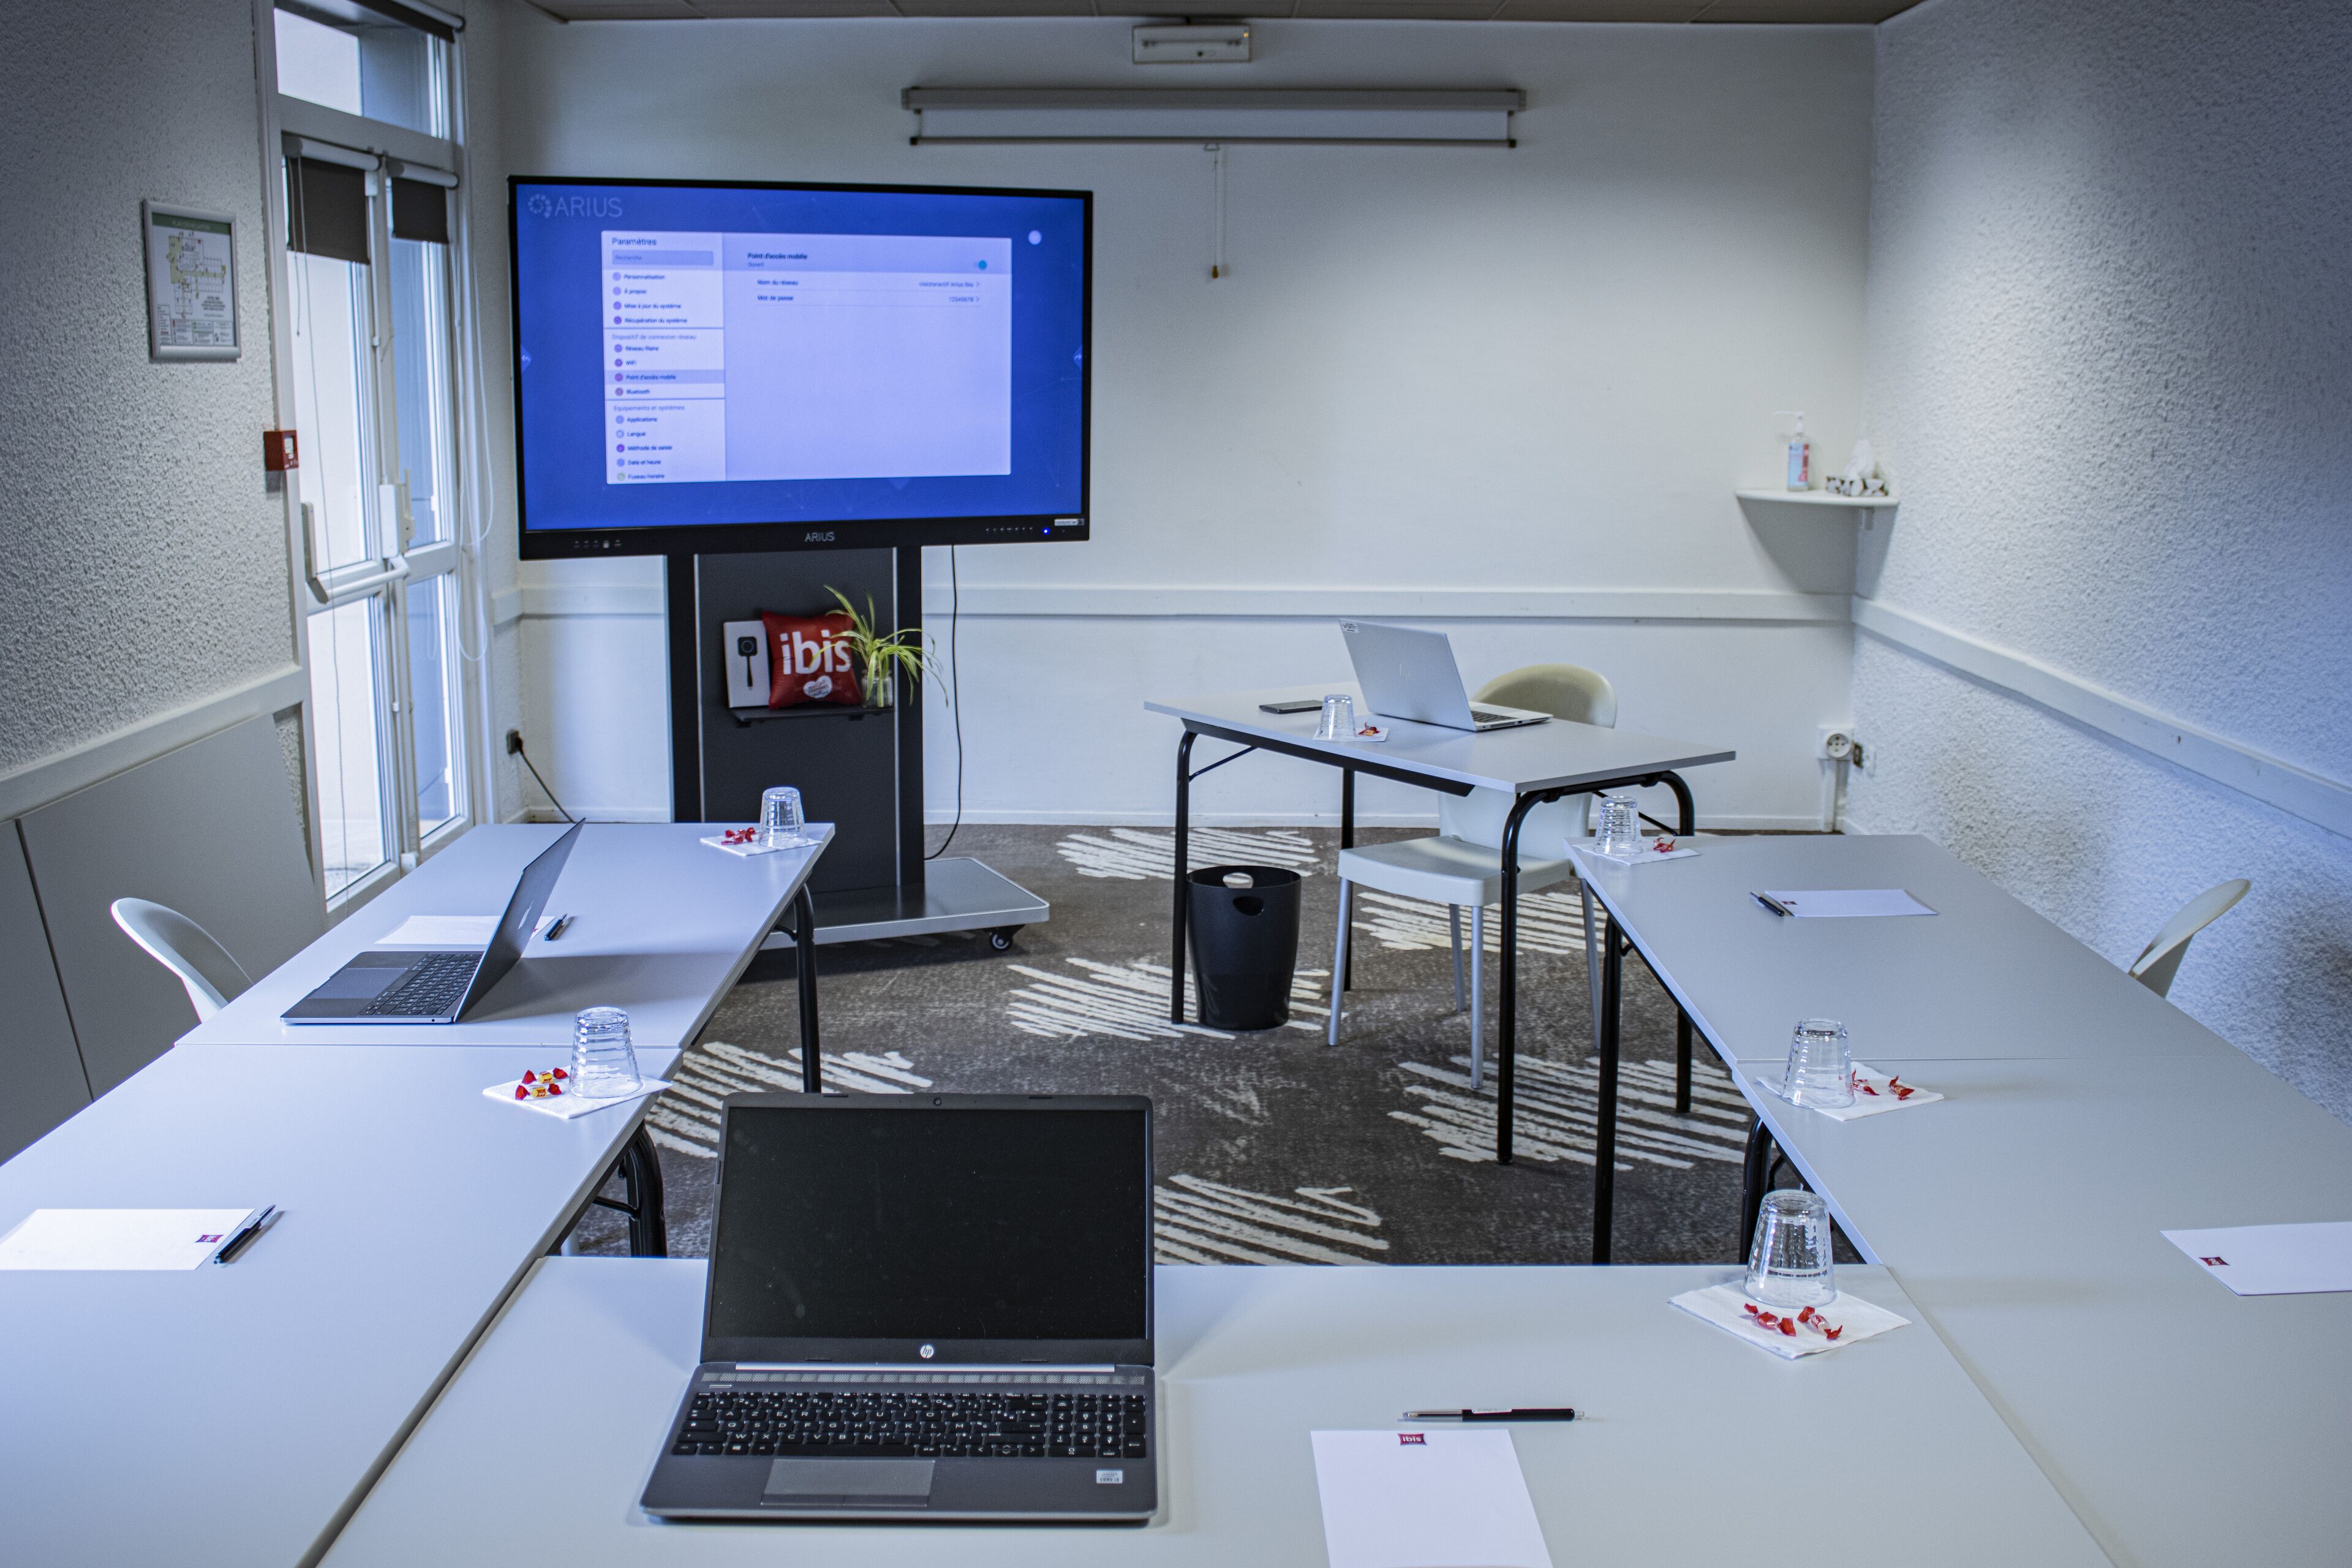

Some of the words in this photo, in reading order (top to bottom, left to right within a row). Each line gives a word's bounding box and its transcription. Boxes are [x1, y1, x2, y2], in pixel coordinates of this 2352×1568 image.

[554, 197, 623, 217] ARIUS
[612, 237, 657, 246] Paramètres
[804, 532, 835, 542] ARIUS
[780, 629, 851, 674] ibis
[921, 1345, 933, 1359] hp
